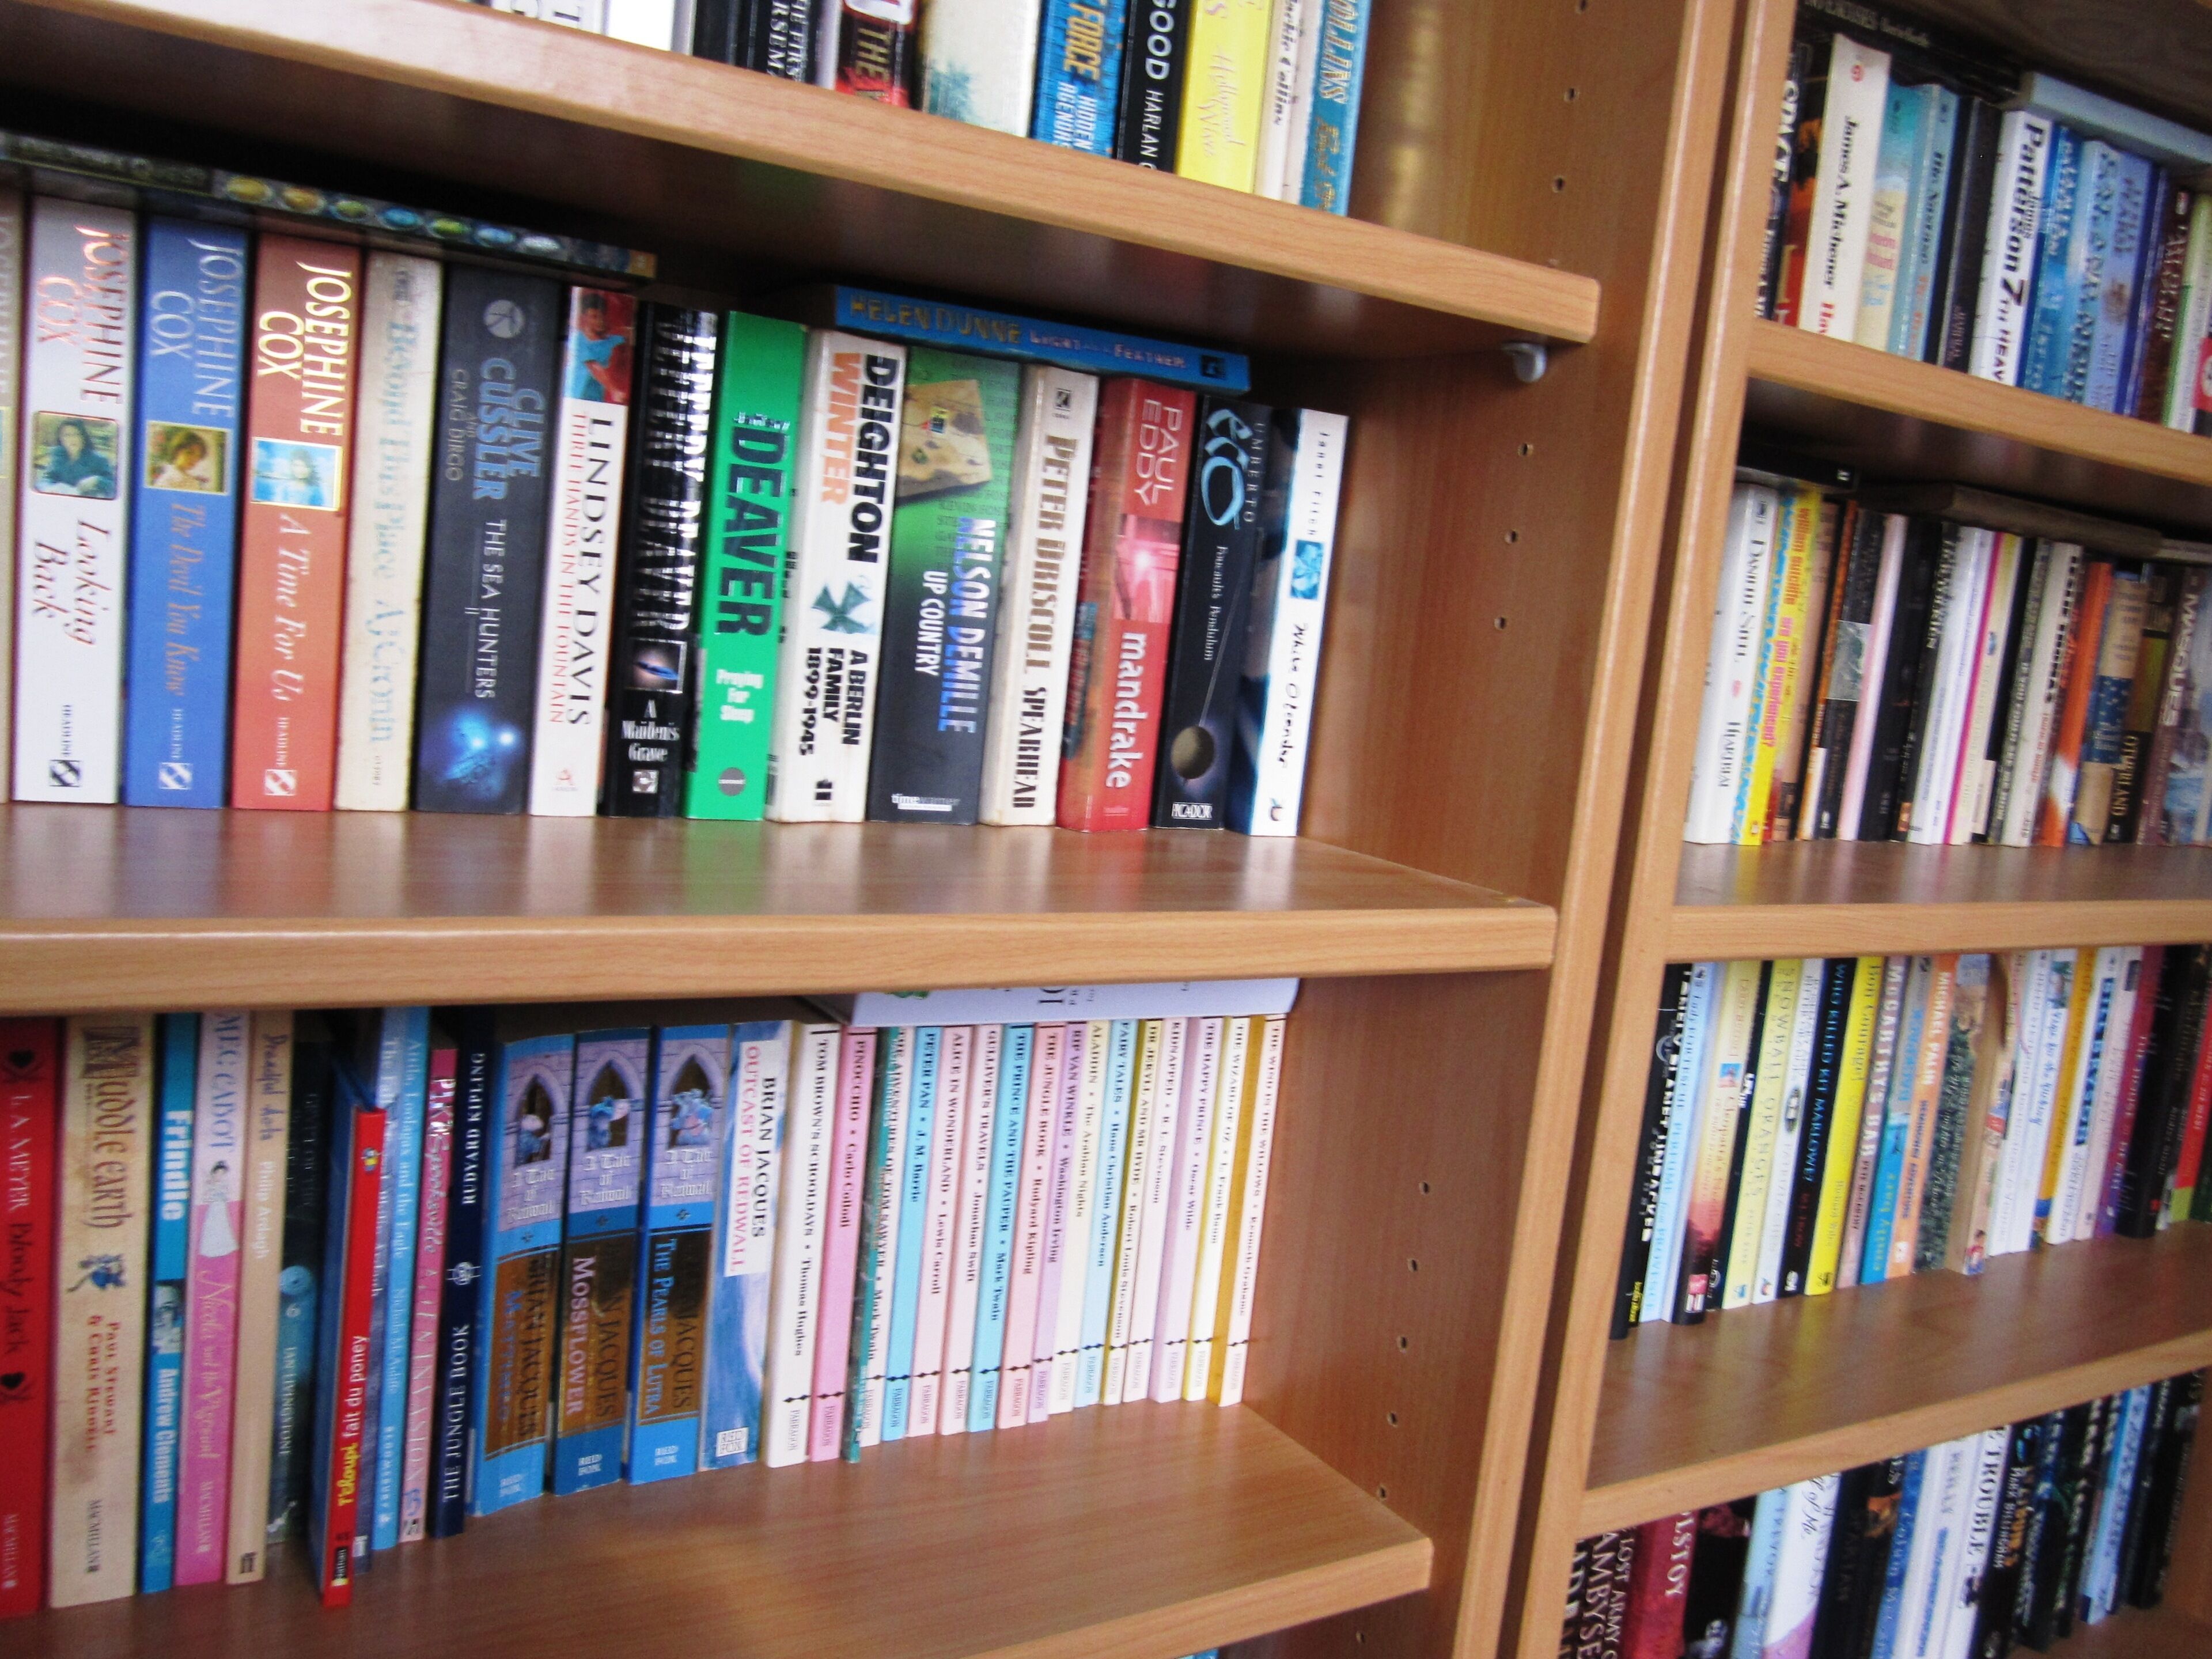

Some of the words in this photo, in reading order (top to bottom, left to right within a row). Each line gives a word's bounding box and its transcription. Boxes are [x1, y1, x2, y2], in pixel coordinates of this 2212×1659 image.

[1063, 2, 1104, 80] FORCE
[1073, 94, 1097, 150] HIDDEN
[1140, 90, 1164, 157] HARLAN
[1839, 115, 1859, 171] James
[2003, 122, 2046, 274] Patterson
[1824, 199, 1850, 290] Michener
[37, 275, 84, 344] COX
[75, 225, 129, 404] JOSEPHINE
[150, 290, 194, 359] COX
[187, 238, 244, 418] JOSEPHINE
[850, 294, 932, 331] HELEN
[935, 306, 1023, 346] DUNNE
[257, 310, 305, 380] COX
[296, 260, 352, 436] JOSEPHINE
[472, 357, 517, 501] CUSSLER
[514, 388, 545, 478] CLIVE
[567, 412, 587, 470] THREE
[820, 351, 862, 506] WINTER
[1133, 398, 1161, 506] EDDY
[1150, 406, 1184, 505] PAUL
[1313, 431, 1331, 479] JANET
[846, 353, 900, 564] DEIGHTON
[1039, 434, 1078, 531] PETER
[1243, 422, 1266, 523] UMBERTO
[171, 503, 206, 537] The
[279, 514, 312, 536] A
[561, 479, 582, 546] HANDS
[578, 417, 613, 594] LINDSEY
[713, 426, 791, 637] DEAVER
[1307, 491, 1323, 536] FITCH
[483, 519, 507, 557] THE
[559, 554, 575, 574] IN
[32, 541, 70, 618] Back
[65, 520, 111, 646] Looking
[168, 544, 203, 596] Devil
[275, 547, 311, 608] Time
[481, 563, 505, 599] SEA
[922, 570, 949, 596] UP
[948, 517, 997, 619] NELSON
[556, 584, 574, 615] THE
[1025, 538, 1067, 669] DRISCOLL
[274, 616, 307, 660] For
[474, 608, 501, 699] HUNTERS
[850, 650, 868, 666] A
[914, 597, 946, 677] COUNTRY
[1203, 605, 1222, 661] Pendulum
[271, 669, 304, 702] Us
[548, 625, 571, 724] FOUNTAIN
[567, 609, 599, 726] DAVIS
[821, 647, 844, 724] FAMILY
[937, 626, 987, 734] DEMILLE
[798, 646, 823, 756] 1899-1945
[840, 671, 866, 746] BERLIN
[1105, 631, 1149, 789] mandrake
[1012, 686, 1047, 808] SPEARHEAD
[1171, 802, 1213, 821] PICADOR
[1828, 963, 1846, 1005] WHO
[1929, 971, 1950, 1036] MICHAEL
[816, 1039, 829, 1073] TOM
[923, 1033, 937, 1077] PETER
[950, 1032, 964, 1075] ALICE
[1014, 1031, 1029, 1061] THE
[1044, 1033, 1058, 1061] THE
[1820, 1010, 1841, 1063] KILLED
[1922, 1042, 1942, 1086] PALIN
[467, 1052, 487, 1125] KIPLING
[740, 1044, 762, 1138] OUTCAST
[849, 1040, 866, 1122] PINOCCHIO
[918, 1081, 932, 1110] PAN
[949, 1078, 960, 1093] IN
[981, 1029, 998, 1109] GULLIVER'S
[1009, 1064, 1025, 1116] PRINCE
[1039, 1066, 1054, 1118] JUNGLE
[1816, 1067, 1832, 1090] KIT
[759, 1076, 777, 1142] BRIAN
[810, 1075, 826, 1141] BROWN'S
[1005, 1119, 1018, 1149] AND
[162, 1110, 194, 1221] Frindle
[461, 1128, 482, 1206] RUDYARD
[738, 1143, 753, 1167] OF
[843, 1142, 857, 1179] Carlo
[940, 1097, 960, 1194] WONDERLAND
[976, 1113, 991, 1172] TRAVELS
[1003, 1150, 1016, 1180] THE
[1035, 1121, 1049, 1158] BOOK
[1802, 1094, 1828, 1183] MARLOWE?
[9, 1138, 31, 1210] MEYER
[257, 1161, 276, 1204] Philip
[751, 1149, 773, 1238] JACQUES
[802, 1143, 820, 1237] SCHOOLDAYS
[911, 1164, 923, 1204] Barrie
[730, 1175, 753, 1273] REDWALL
[839, 1183, 854, 1228] Collodi
[934, 1212, 948, 1249] Lewis
[968, 1192, 984, 1249] Jonathan
[998, 1180, 1014, 1233] PAUPER
[1028, 1178, 1043, 1229] Rudyard
[254, 1207, 271, 1260] Ardagh
[654, 1237, 678, 1277] THE
[1022, 1231, 1037, 1275] Kipling
[798, 1259, 815, 1307] Thomas
[930, 1251, 945, 1296] Carroll
[965, 1251, 979, 1283] Swift
[993, 1252, 1007, 1286] Mark
[649, 1276, 675, 1336] PEARLS
[990, 1286, 1005, 1322] Twain
[88, 1334, 102, 1381] Chris
[105, 1321, 121, 1359] Paul
[350, 1335, 370, 1385] poney
[449, 1323, 471, 1379] BOOK
[566, 1256, 597, 1416] MOSSFLOWER
[793, 1310, 808, 1357] Hughes
[104, 1366, 119, 1435] Stewart
[156, 1368, 180, 1429] Andrew
[347, 1387, 364, 1408] du
[643, 1361, 669, 1416] LUTRA
[85, 1387, 101, 1450] Riddell
[342, 1407, 362, 1438] fait
[446, 1384, 467, 1459] JUNGLE
[152, 1431, 176, 1504] Clements
[442, 1464, 461, 1503] THE
[1967, 1446, 2001, 1559] TROUBLE
[1613, 1537, 1635, 1584] LOST
[1607, 1589, 1627, 1646] ARMY
